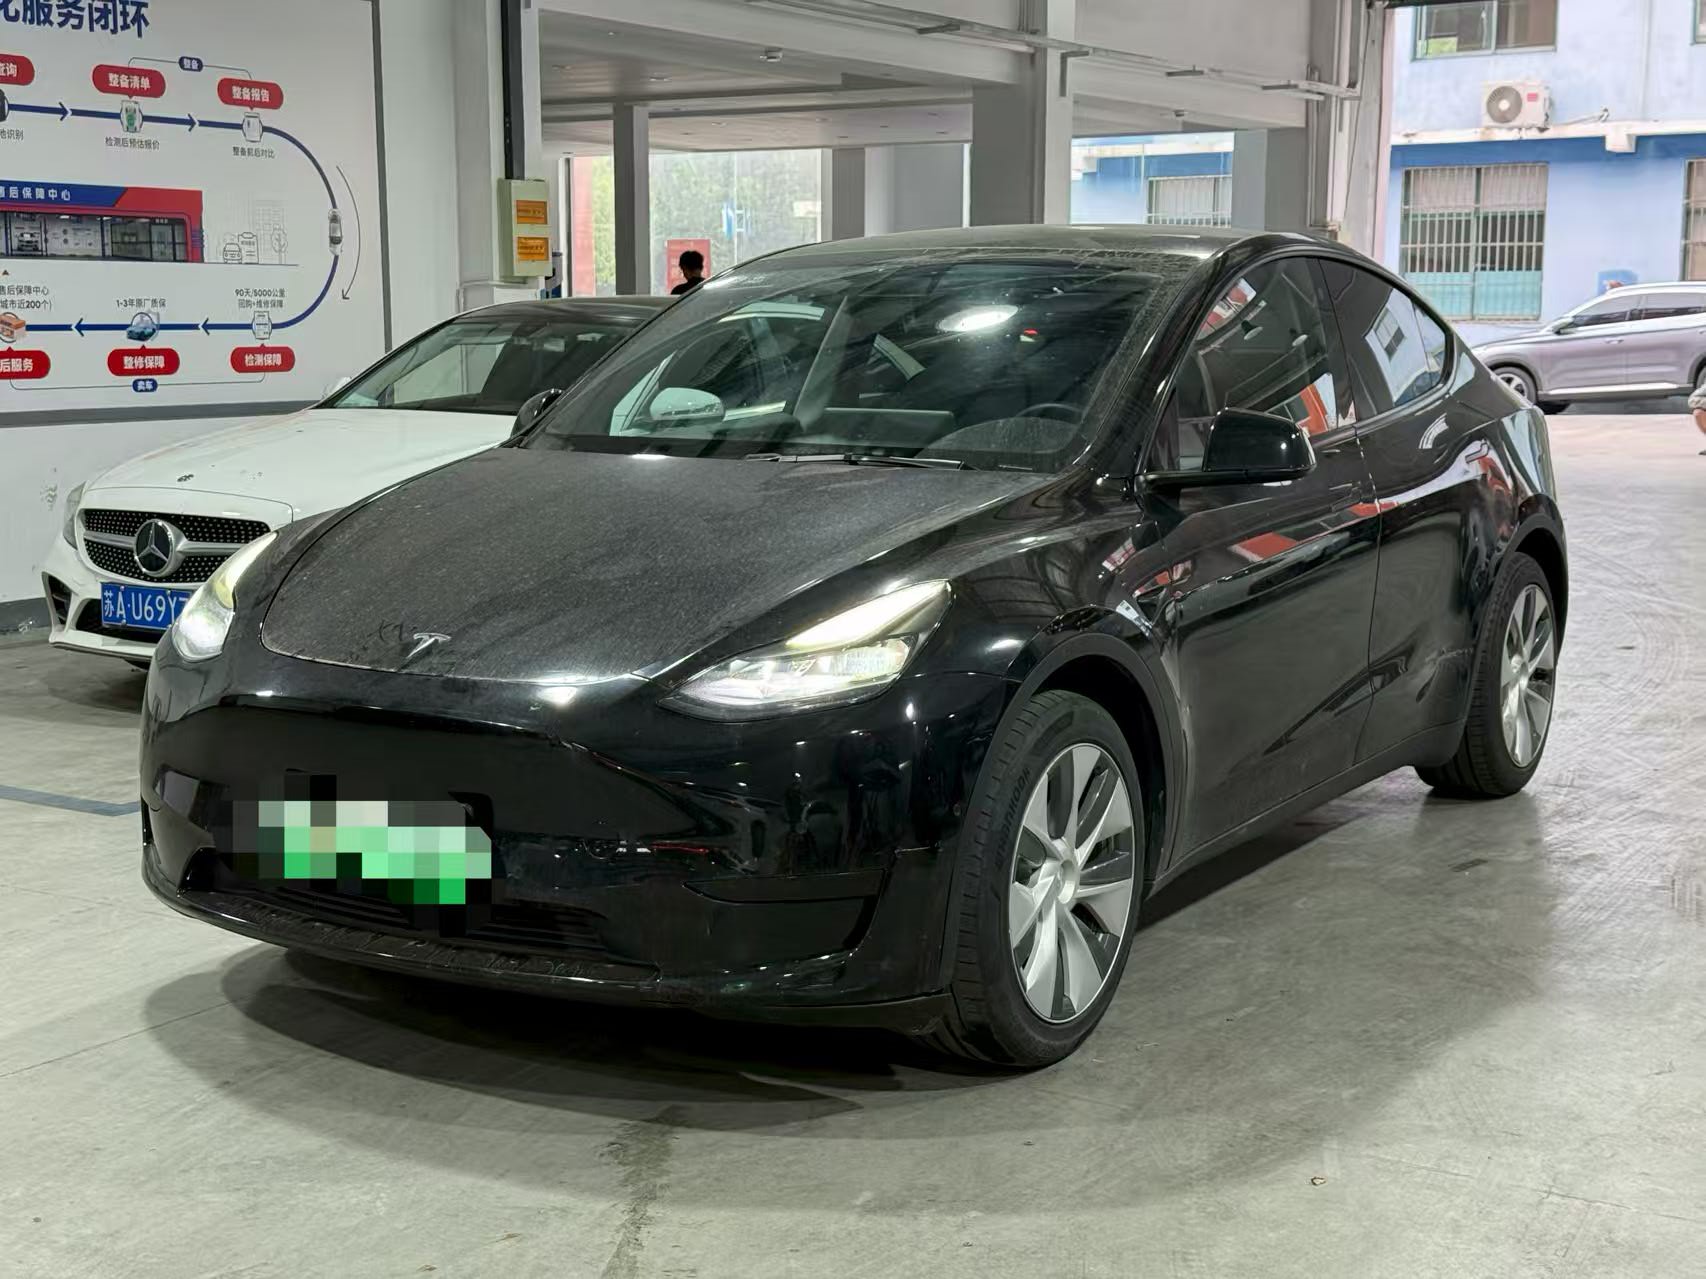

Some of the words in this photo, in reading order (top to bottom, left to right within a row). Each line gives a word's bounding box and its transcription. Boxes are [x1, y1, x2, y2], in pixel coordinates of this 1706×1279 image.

[108, 73, 151, 90] 整备清单
[232, 85, 270, 102] 整备报告
[105, 137, 160, 150] 检测后预估报价
[116, 298, 167, 308] 1-3年原厂质保
[123, 355, 165, 369] 整修保障
[244, 353, 282, 367] 检测保障
